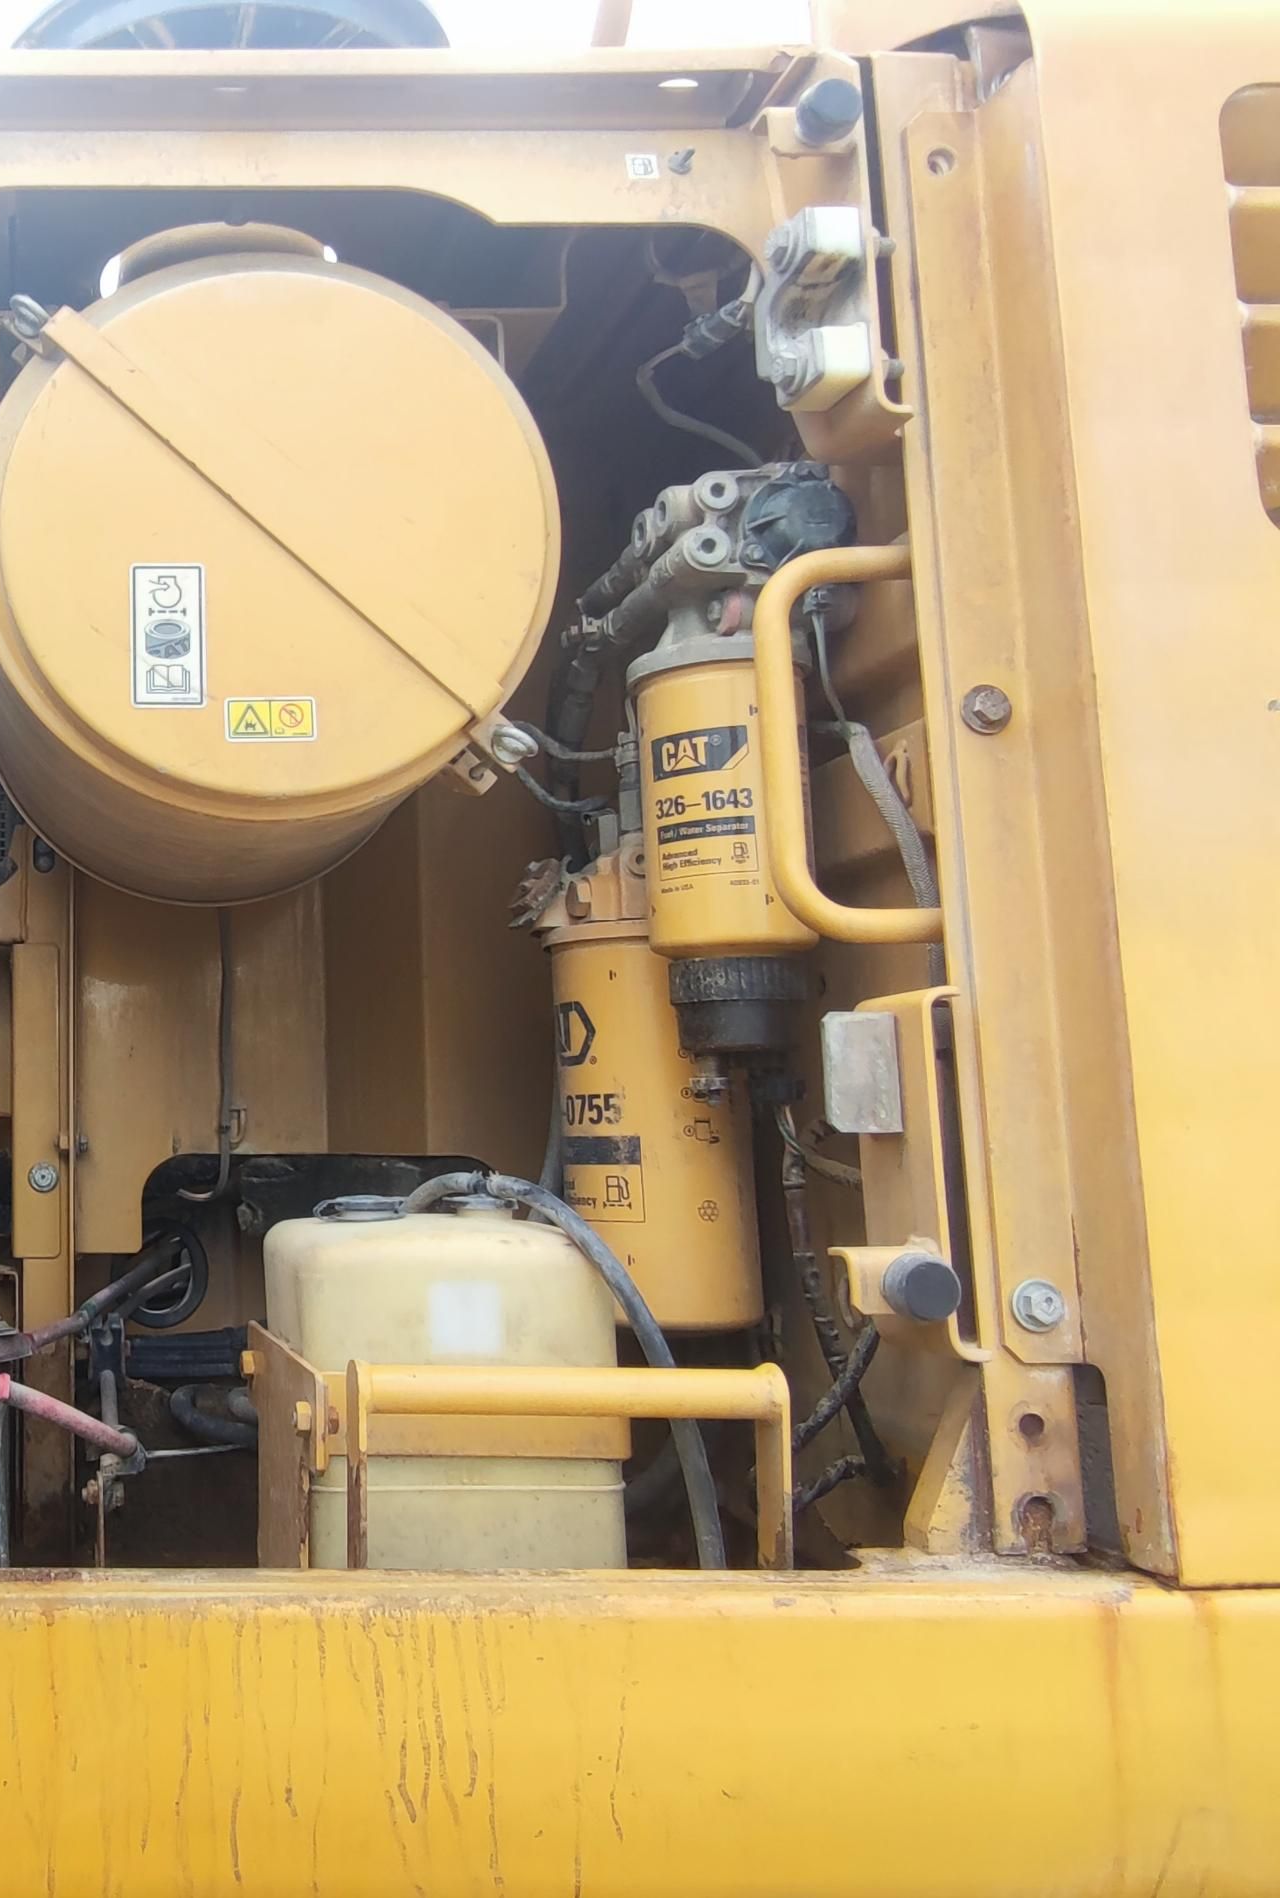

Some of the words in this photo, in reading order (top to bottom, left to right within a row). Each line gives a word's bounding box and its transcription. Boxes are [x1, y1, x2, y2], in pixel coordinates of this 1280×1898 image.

[661, 736, 709, 772] CAT
[655, 787, 753, 820] 326-1643
[705, 821, 749, 833] Separator
[679, 857, 722, 868] Efficiency
